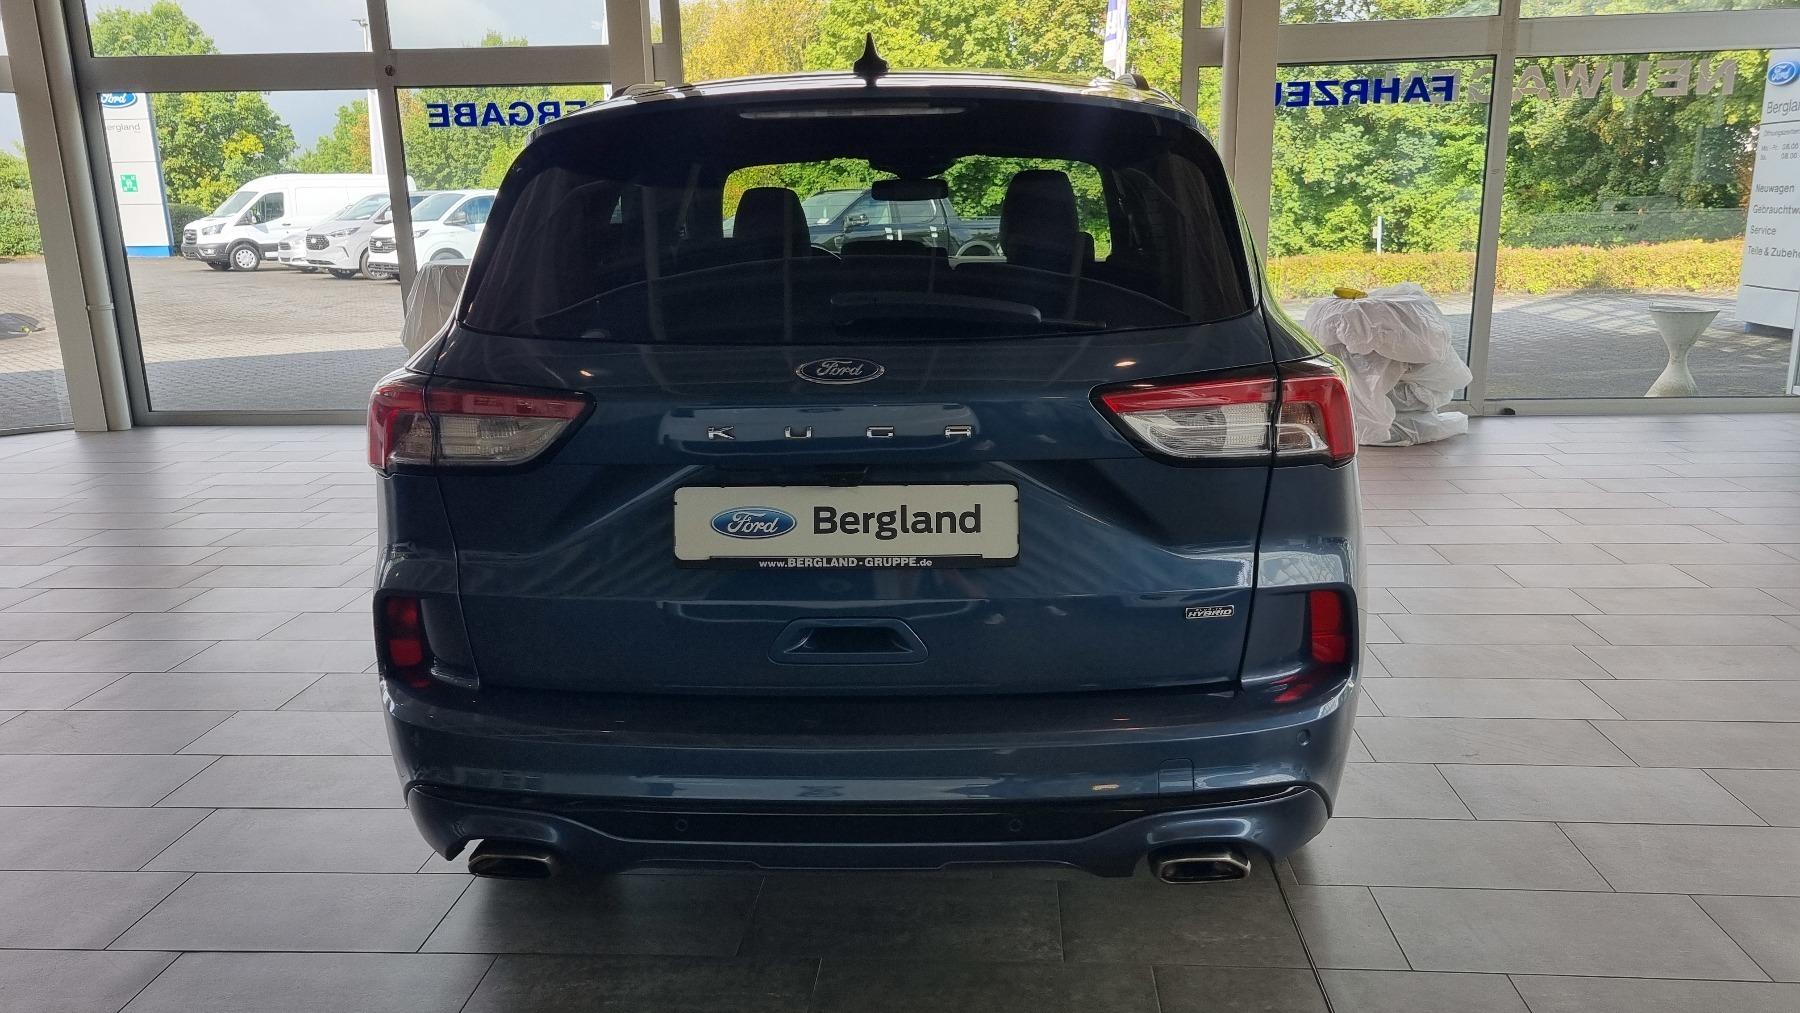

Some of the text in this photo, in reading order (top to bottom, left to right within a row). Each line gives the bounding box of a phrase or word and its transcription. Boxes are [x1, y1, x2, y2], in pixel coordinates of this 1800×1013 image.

[107, 123, 141, 132] ergland
[1756, 183, 1795, 195] Neuwagen
[1750, 224, 1776, 235] Service
[1764, 247, 1770, 257] &
[817, 360, 864, 376] Ford
[727, 504, 982, 541] Ford Bergland
[758, 556, 933, 569] www.BERGLAND-GRUPPE.de
[1188, 609, 1232, 617] HYBRID
